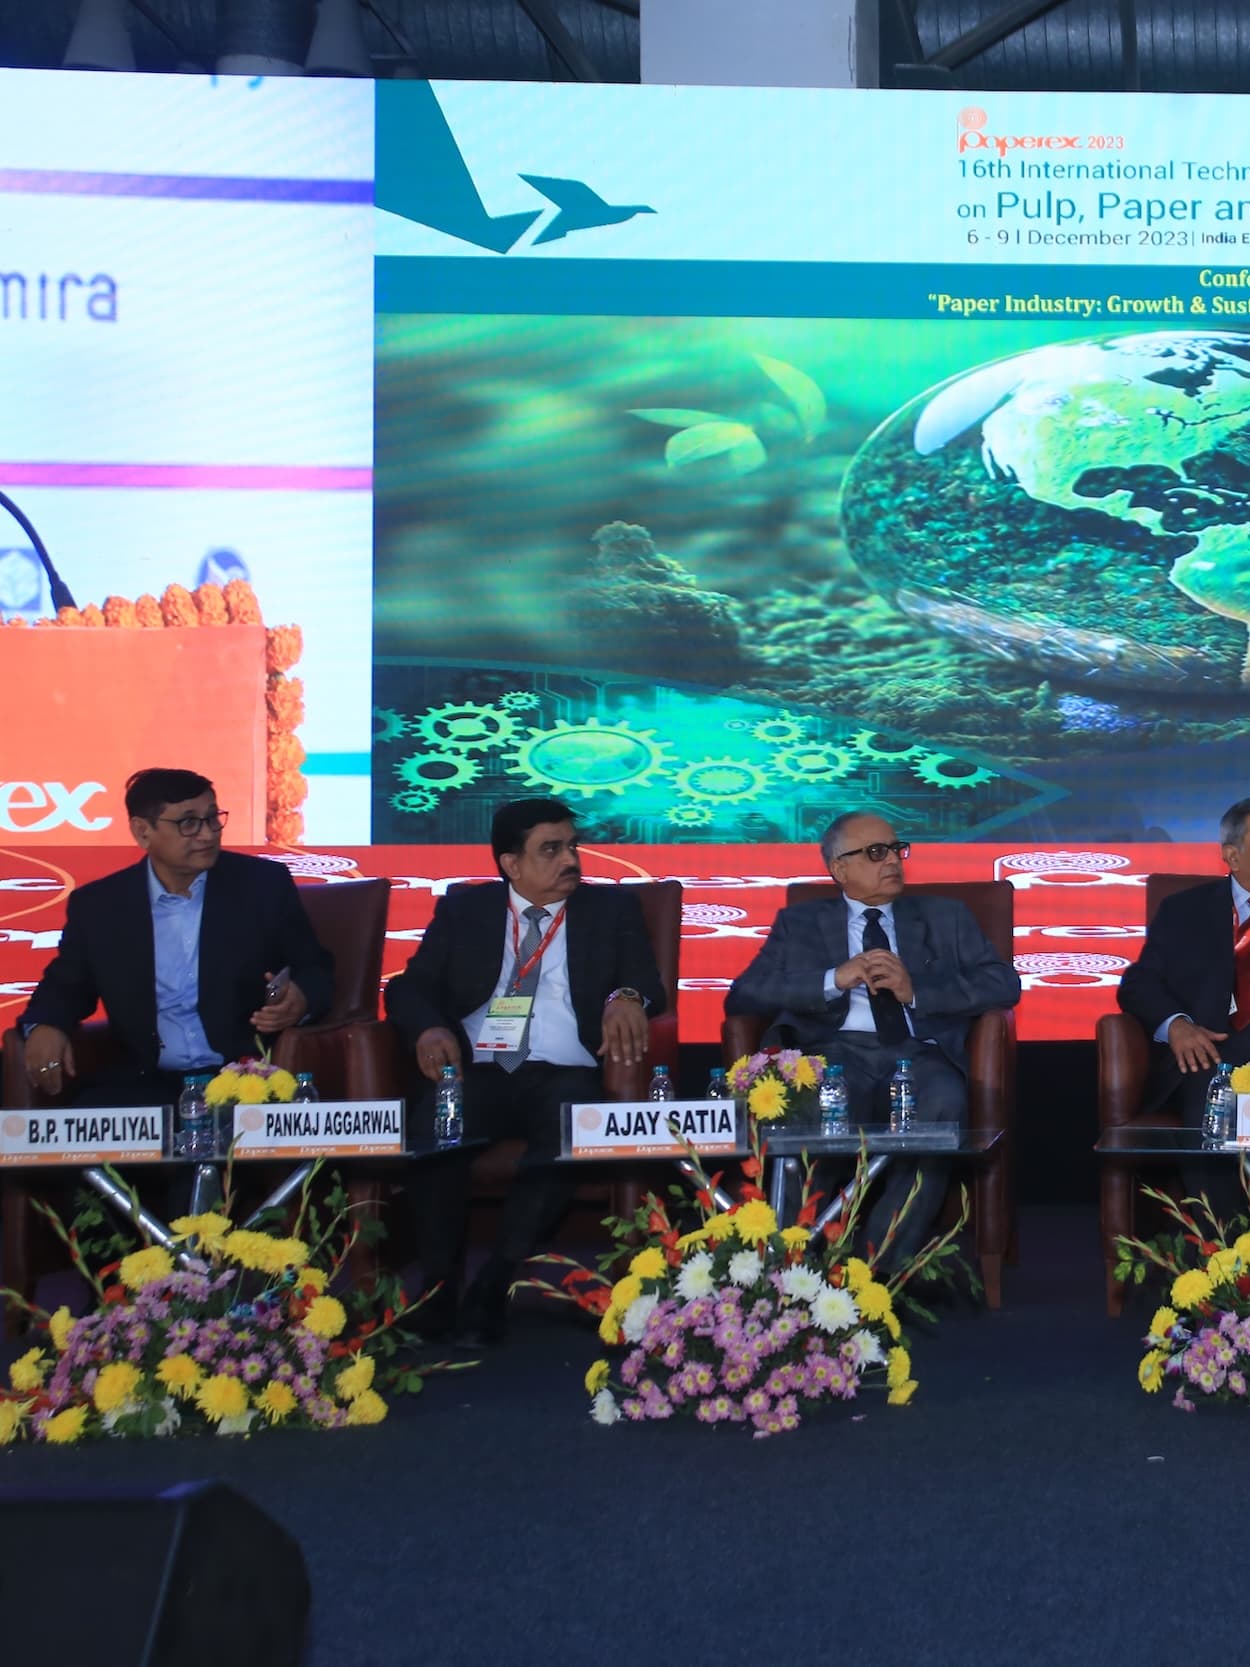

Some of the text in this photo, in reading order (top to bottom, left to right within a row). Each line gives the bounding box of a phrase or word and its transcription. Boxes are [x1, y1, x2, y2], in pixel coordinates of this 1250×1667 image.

[1087, 136, 1125, 150] 2023
[959, 159, 1011, 180] 16th
[1021, 159, 1174, 181] International
[957, 202, 986, 219] on
[997, 191, 1085, 226] Pulp,
[1099, 192, 1203, 226] Paper
[967, 230, 979, 245] 6
[998, 230, 1009, 245] 9
[1029, 230, 1131, 246] December
[1202, 232, 1237, 245] India
[1005, 294, 1101, 317] Industry:
[1107, 295, 1185, 315] Growth
[1190, 295, 1206, 315] &
[28, 1116, 160, 1143] B.P. THAPLIYAL
[266, 1109, 400, 1137] PANKAJ AGGARWAL
[604, 1109, 733, 1137] AJAY SATIA
